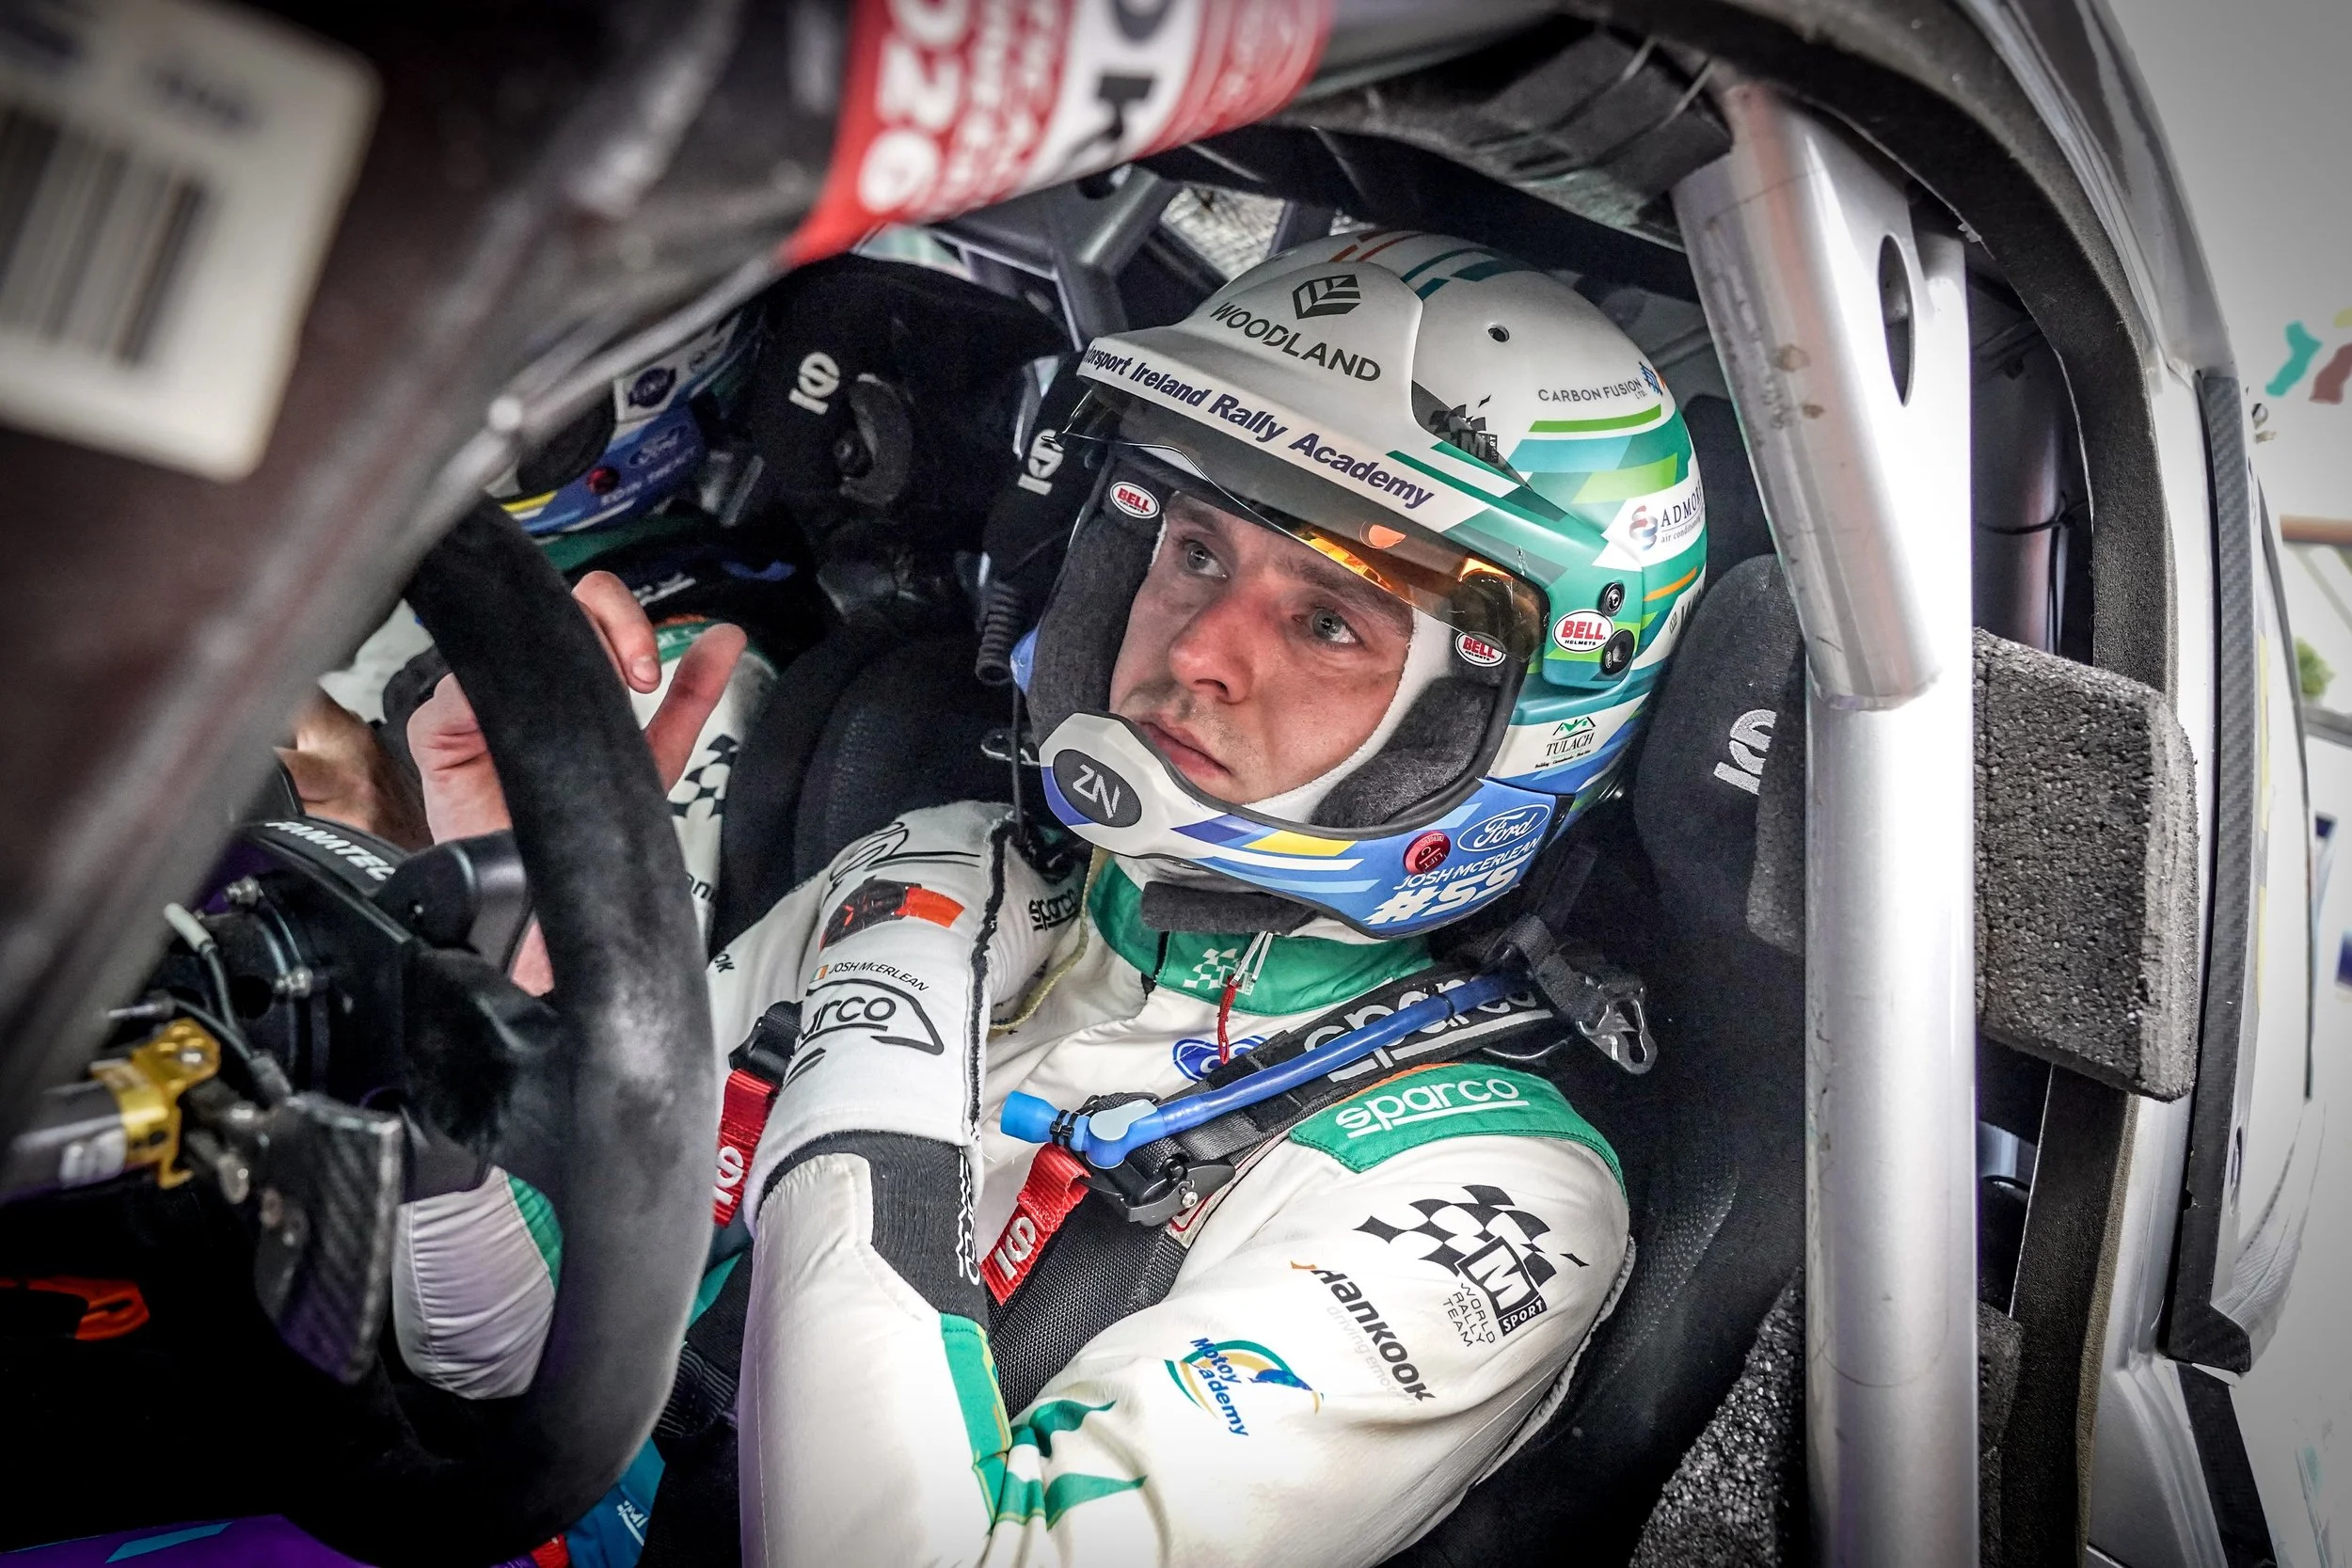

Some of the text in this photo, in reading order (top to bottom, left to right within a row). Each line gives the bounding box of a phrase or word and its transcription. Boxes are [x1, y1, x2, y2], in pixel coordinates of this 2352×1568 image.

[1210, 301, 1381, 382] WOODLAND
[1538, 377, 1643, 404] CARBON FUSION
[1083, 344, 1435, 509] torsport Ireland Rally Academy
[1117, 487, 1150, 513] BELL
[1462, 636, 1496, 659] BELL
[1561, 620, 1604, 641] BELL
[1546, 733, 1595, 757] TULACH
[1392, 867, 1454, 891] JOSH
[829, 961, 860, 974] JOSH
[1336, 1078, 1520, 1132] sparco
[1327, 1306, 1371, 1354] driving
[1441, 1298, 1473, 1347] TEAM
[1453, 1291, 1486, 1344] RALLY
[1461, 1282, 1496, 1344] WORLD
[1502, 1298, 1545, 1332] SPORT
